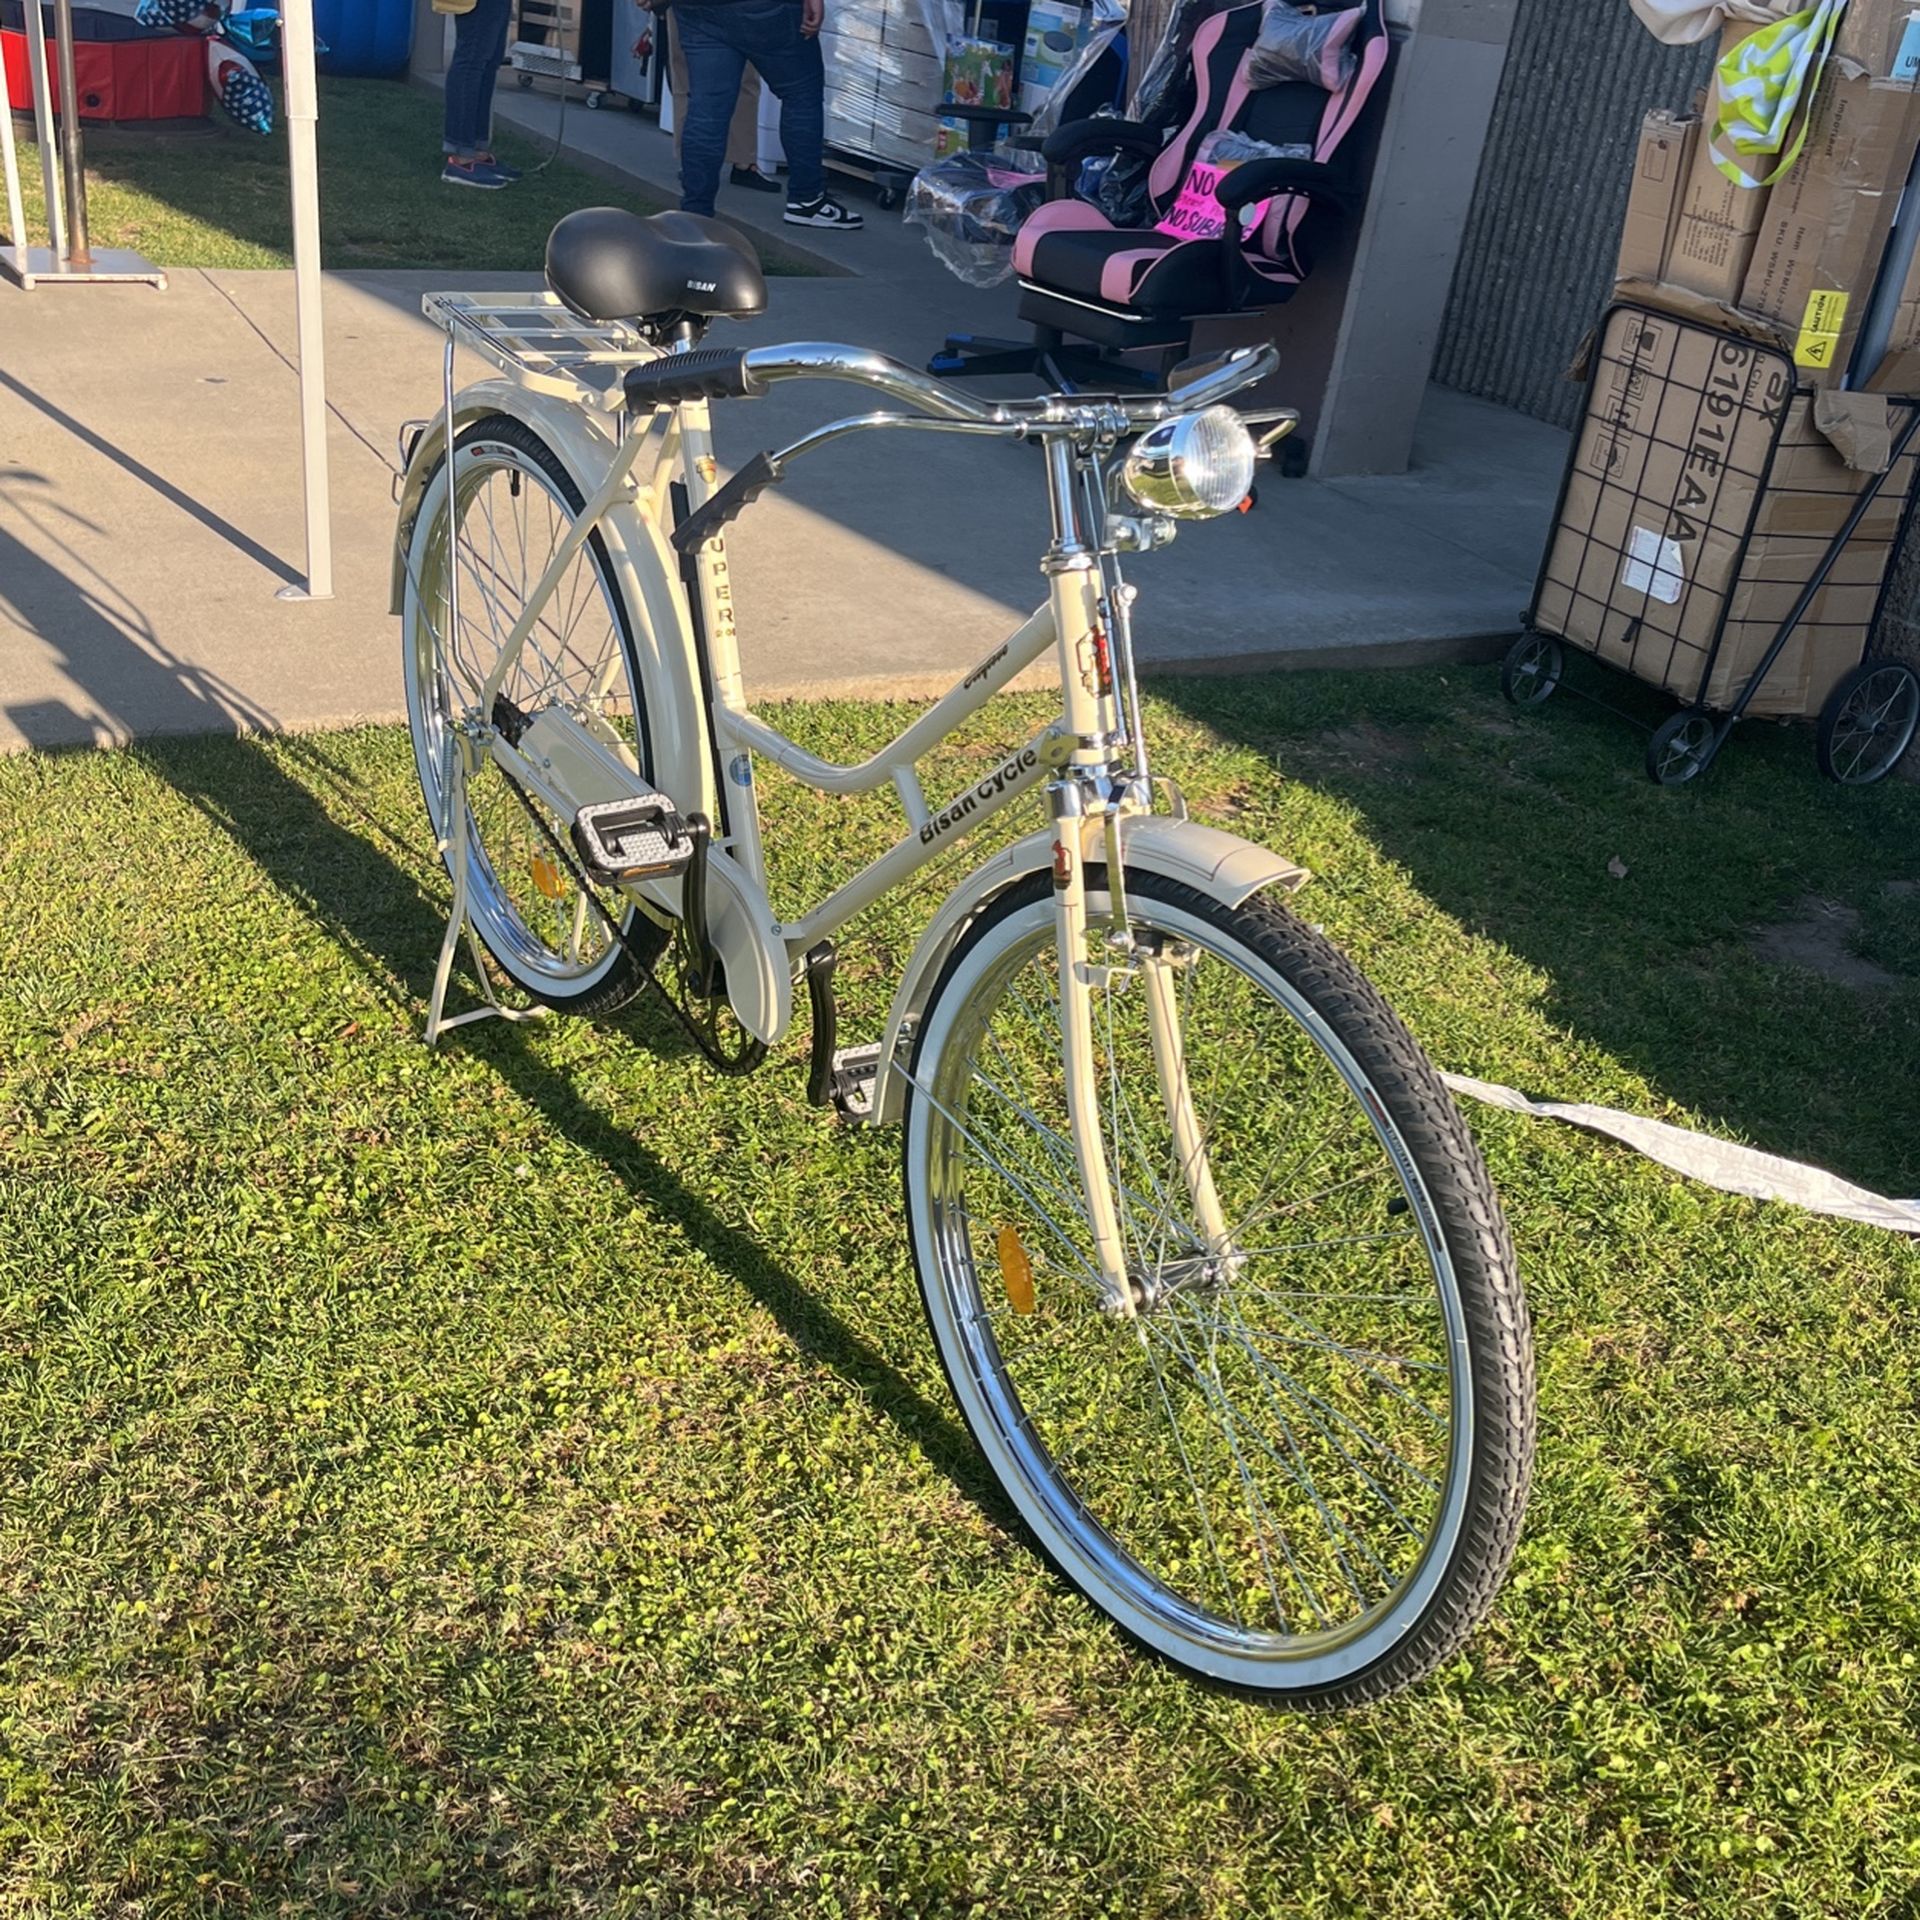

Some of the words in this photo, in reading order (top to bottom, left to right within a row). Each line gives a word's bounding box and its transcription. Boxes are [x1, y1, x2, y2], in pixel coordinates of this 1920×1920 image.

[1825, 99, 1848, 157] Important
[1185, 169, 1215, 196] NO
[1163, 206, 1189, 228] NO
[1811, 295, 1826, 332] CAUTION
[711, 537, 734, 623] UPER
[919, 794, 978, 845] Bisan
[977, 749, 1038, 799] Cycle
